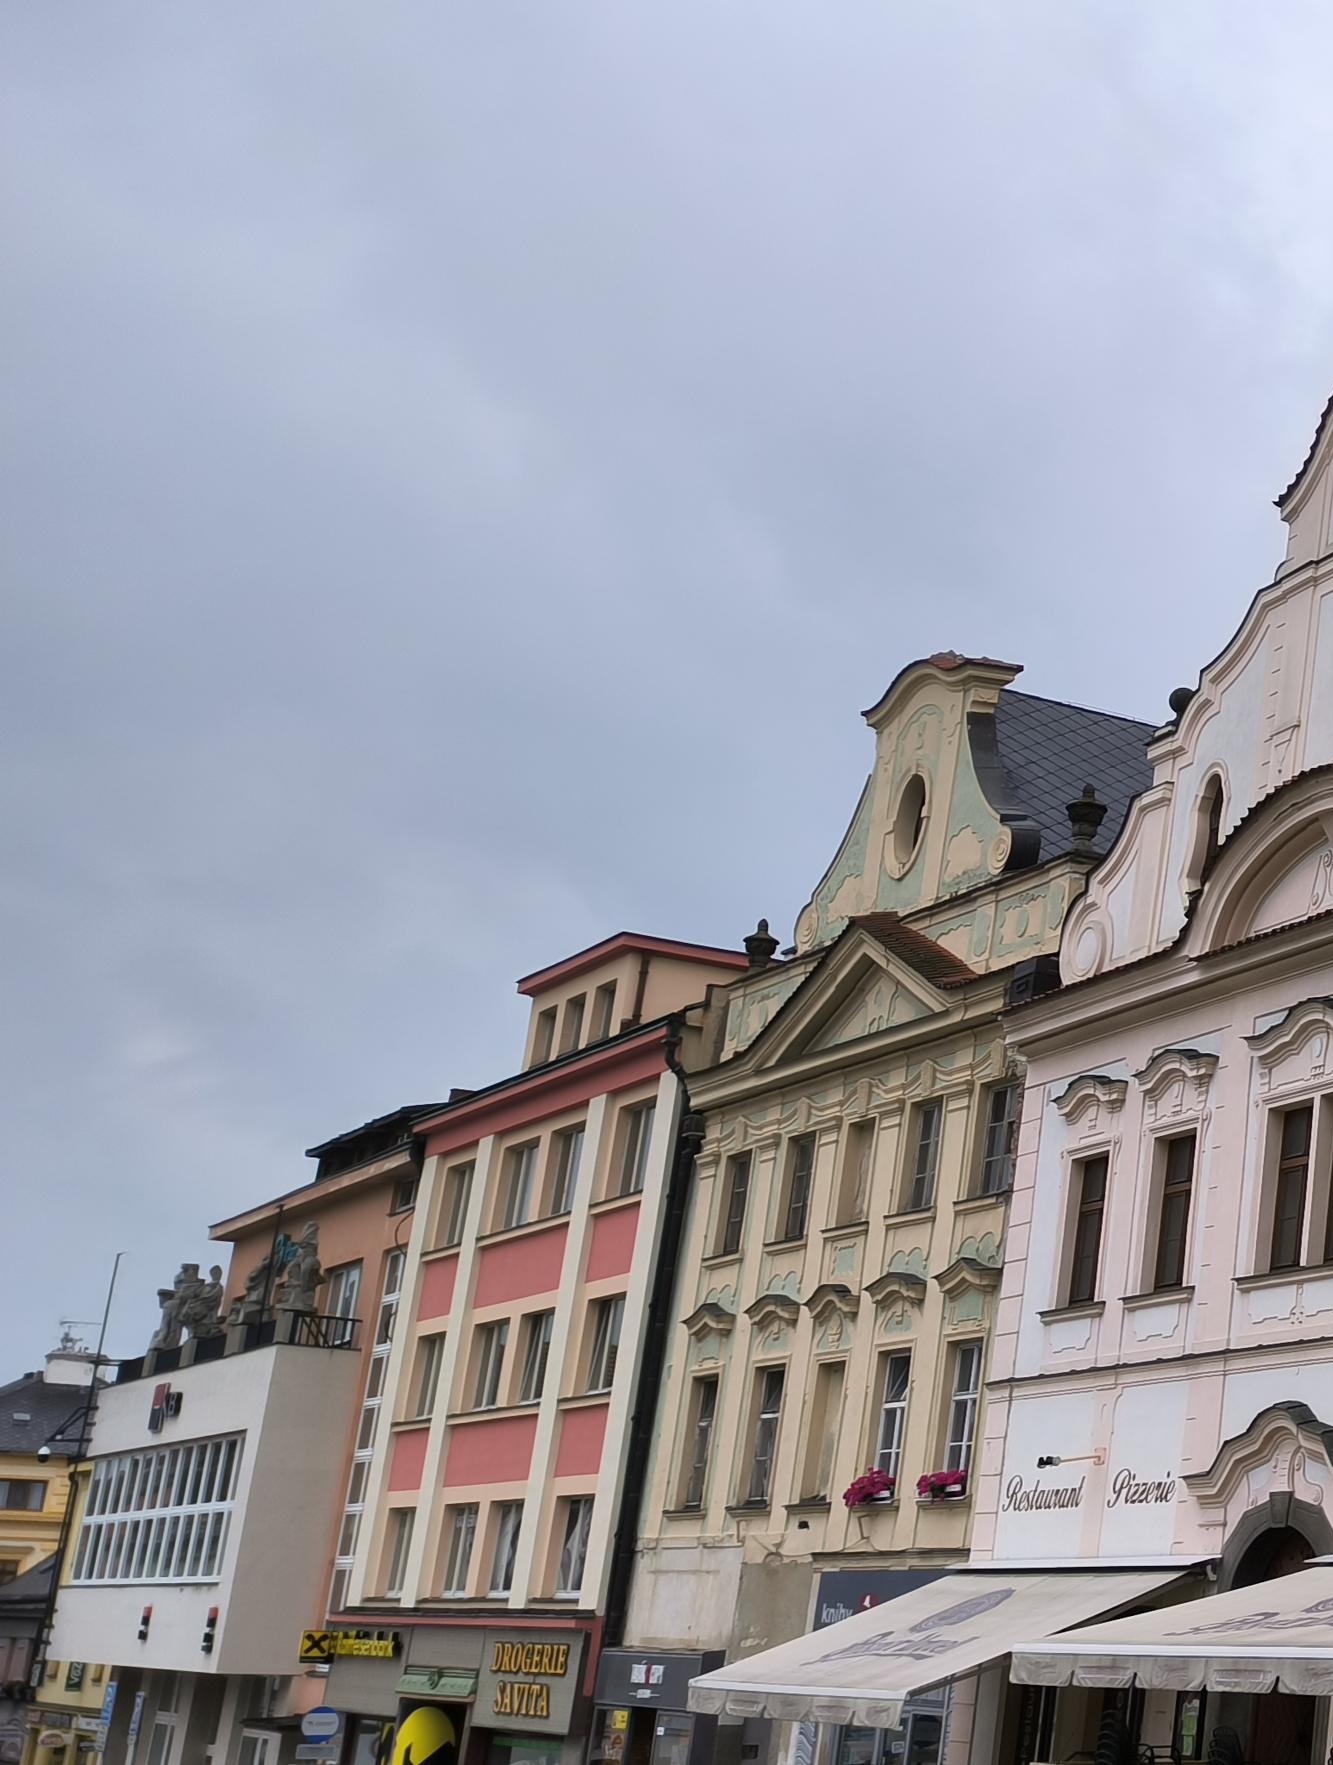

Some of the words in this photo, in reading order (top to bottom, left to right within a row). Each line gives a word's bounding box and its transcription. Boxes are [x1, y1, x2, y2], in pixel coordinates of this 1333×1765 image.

[1001, 1475, 1087, 1513] Restaurant
[1106, 1468, 1177, 1509] Pizzerie
[491, 1641, 570, 1677] DROGERIE
[493, 1681, 550, 1718] SAVITA
